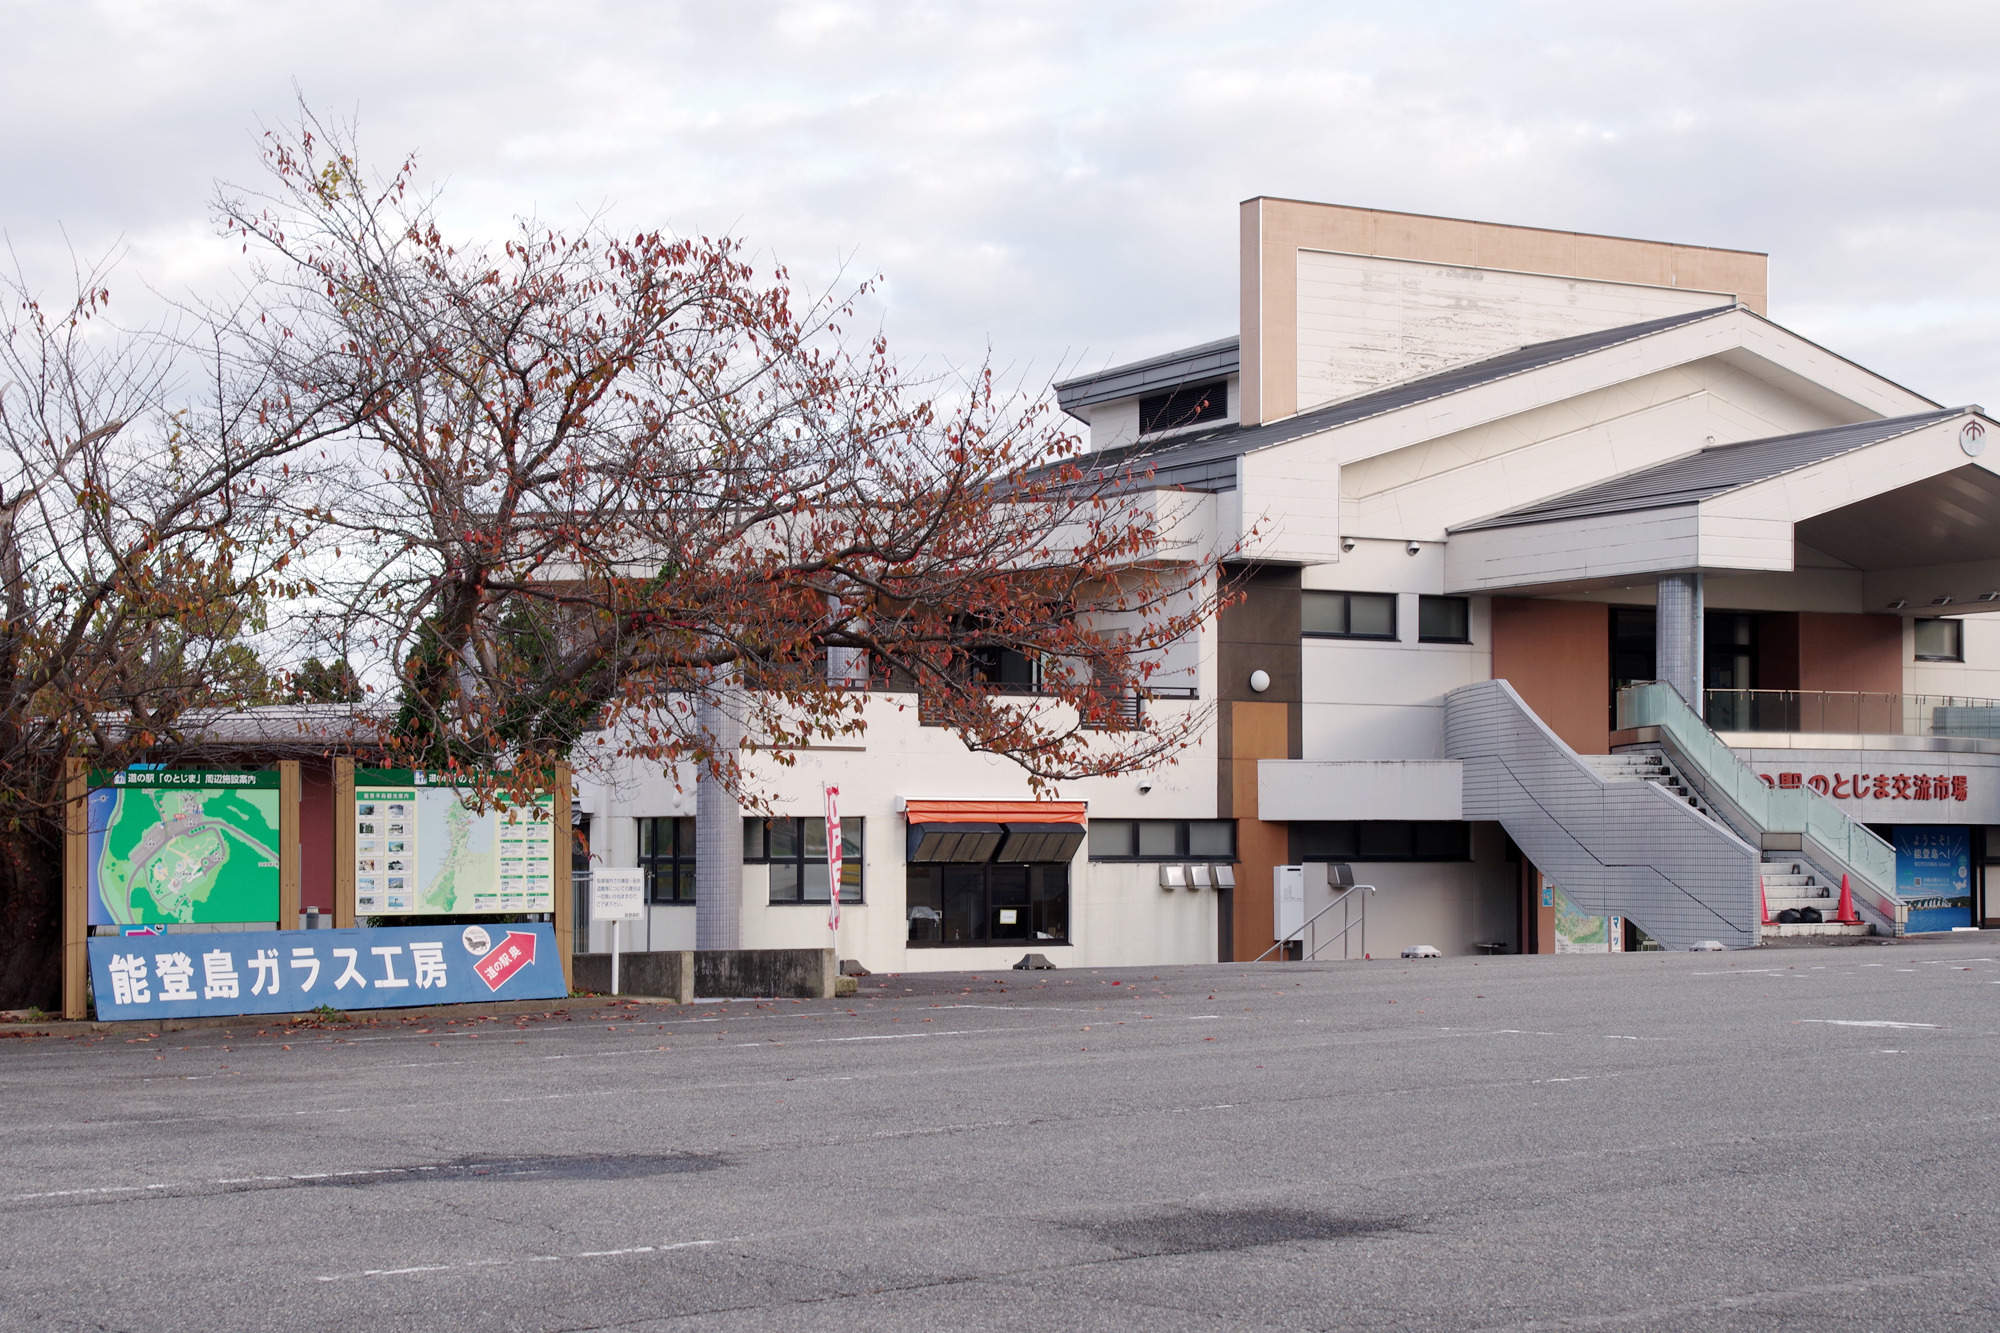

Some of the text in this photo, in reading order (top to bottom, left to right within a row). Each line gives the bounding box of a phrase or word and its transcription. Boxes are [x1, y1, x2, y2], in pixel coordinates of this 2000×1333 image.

[108, 942, 448, 1005] 能登島ガラス工房
